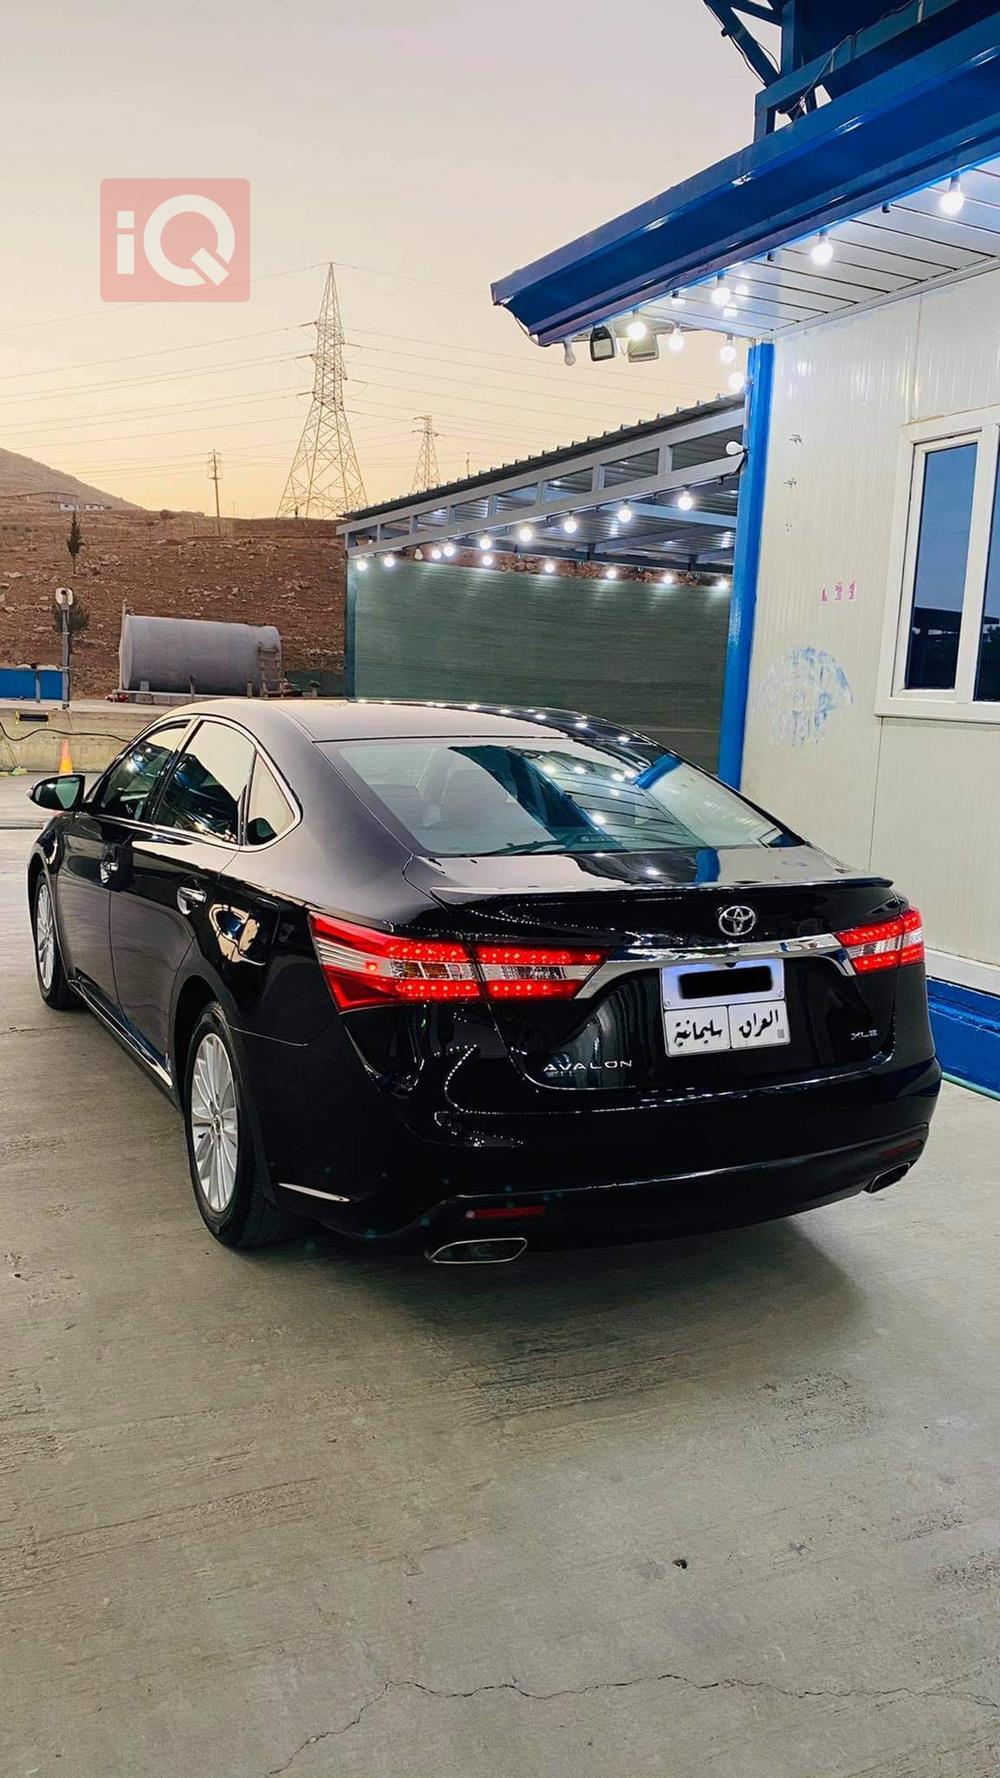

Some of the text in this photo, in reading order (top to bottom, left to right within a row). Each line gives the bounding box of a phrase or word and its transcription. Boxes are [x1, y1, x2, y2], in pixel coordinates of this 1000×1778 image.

[674, 1009, 779, 1047] العراق سليمانية
[850, 1029, 879, 1041] XLE
[543, 1059, 633, 1073] AVALON
